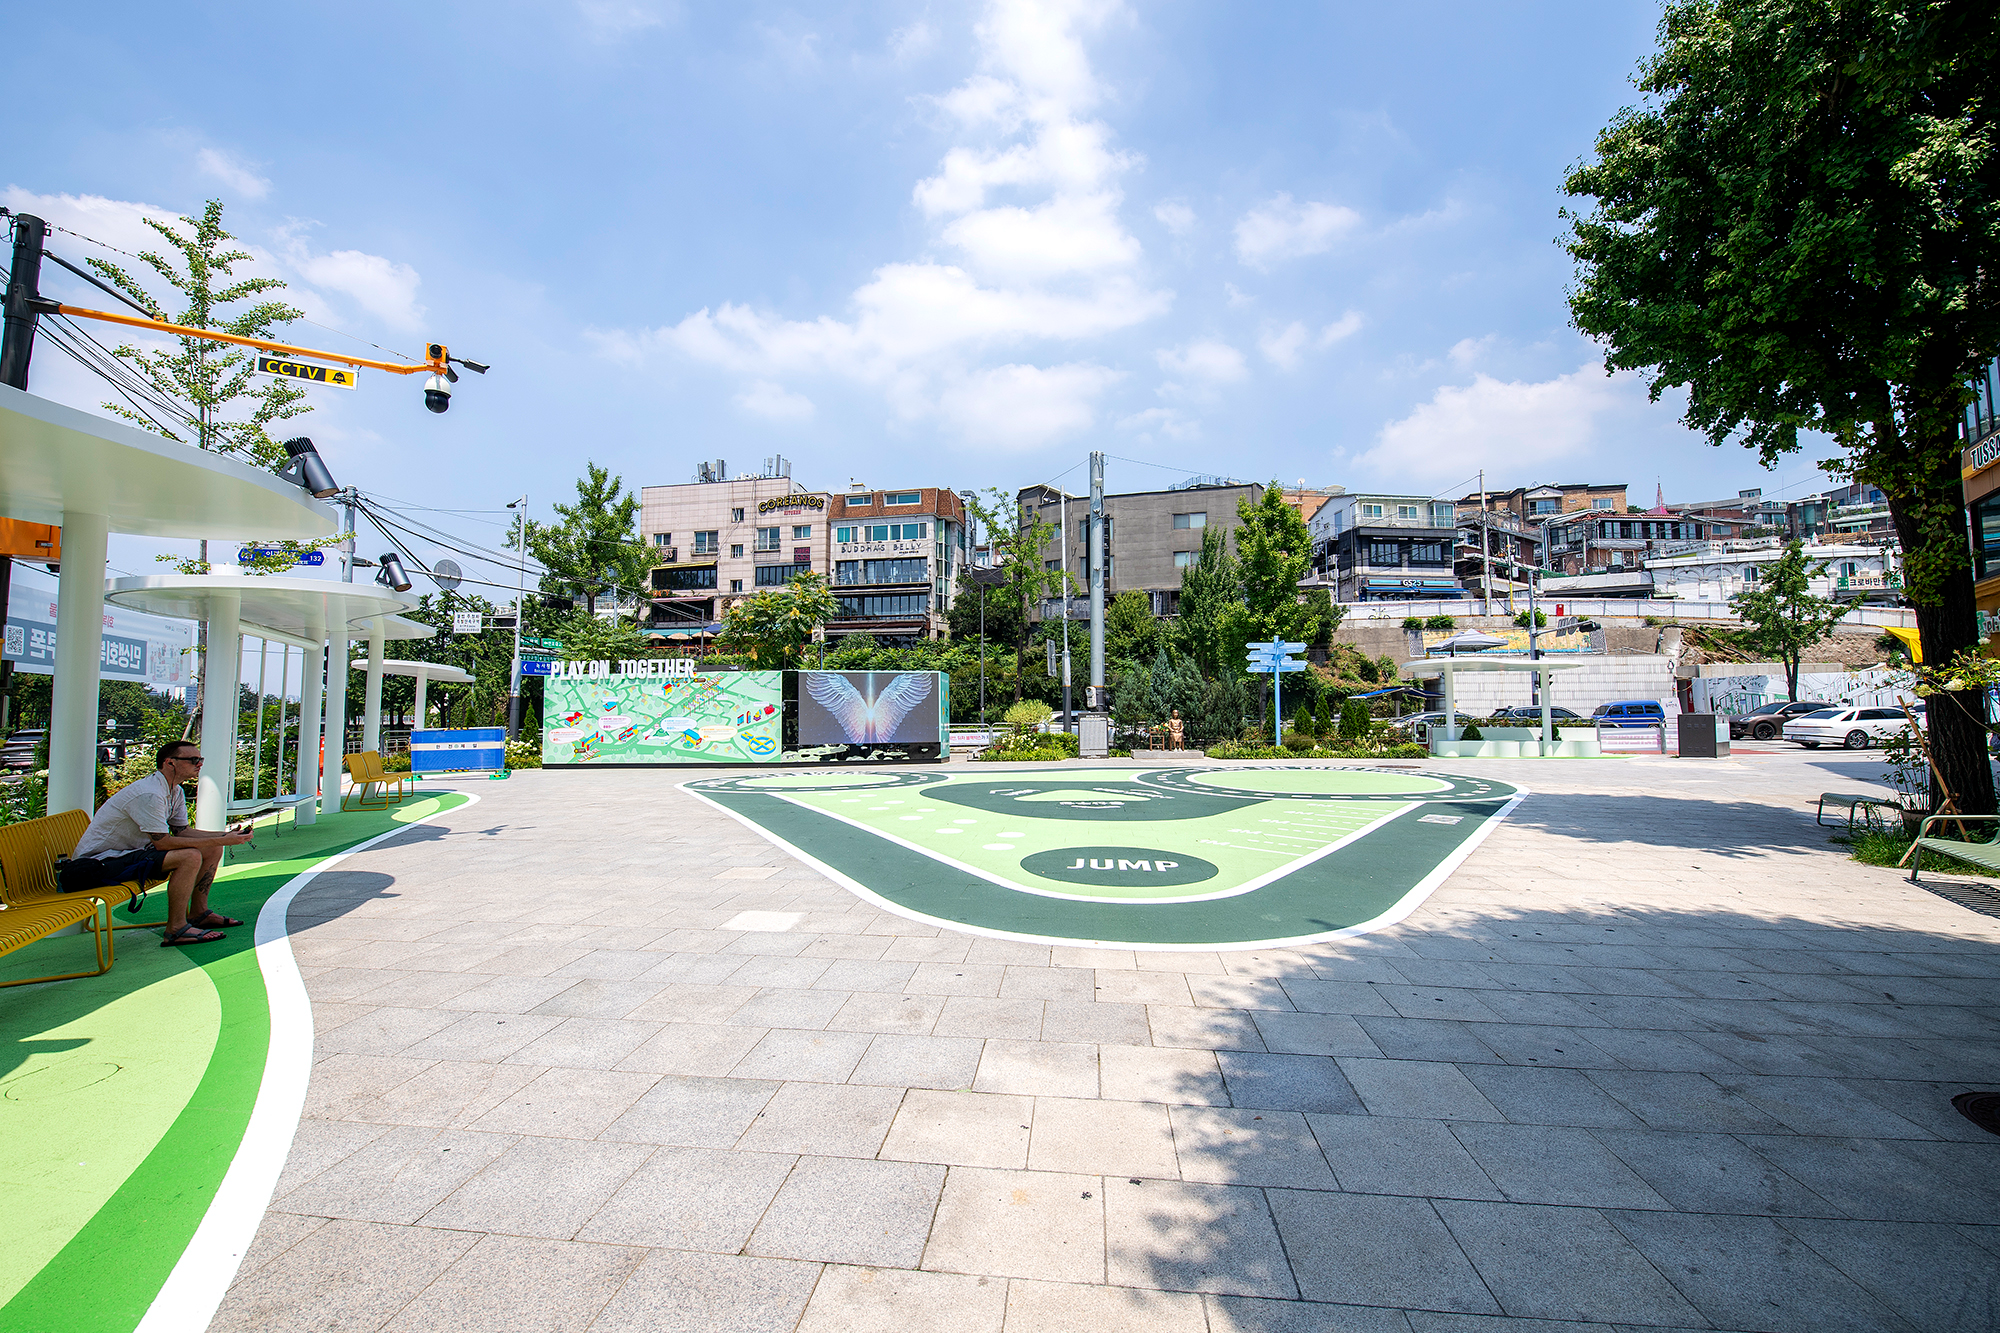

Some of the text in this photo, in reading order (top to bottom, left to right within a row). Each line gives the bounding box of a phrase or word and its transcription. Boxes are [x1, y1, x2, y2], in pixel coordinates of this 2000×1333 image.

[266, 360, 319, 379] CCTV
[758, 495, 825, 513] COREANOS
[841, 542, 922, 554] BUDDHA'S BELLY
[1402, 579, 1422, 587] GS25
[550, 658, 695, 682] PLAY ON, TOGETHER
[1066, 858, 1180, 872] JUMP
